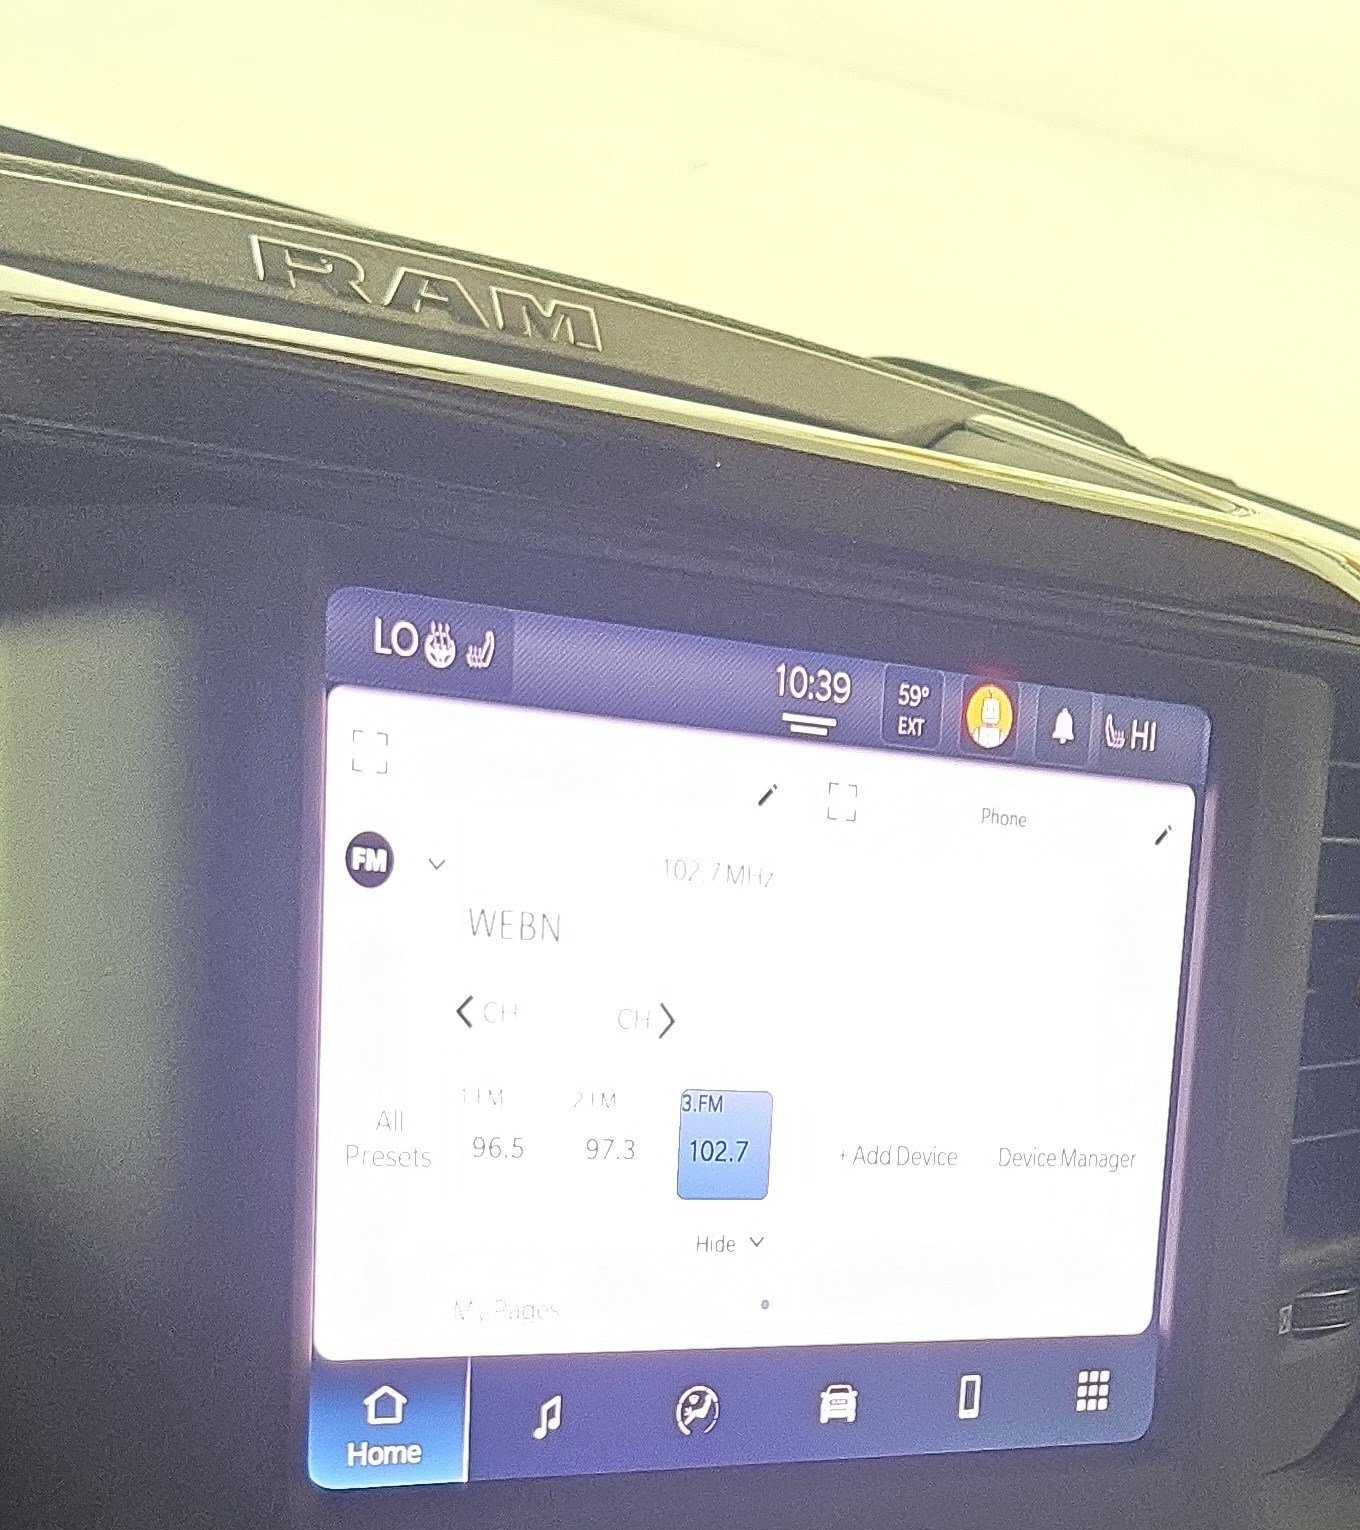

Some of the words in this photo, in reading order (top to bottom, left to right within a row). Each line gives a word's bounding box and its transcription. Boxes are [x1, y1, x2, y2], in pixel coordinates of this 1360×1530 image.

[250, 233, 602, 352] RAM
[374, 616, 419, 657] LO
[776, 663, 852, 704] 10:39
[897, 716, 925, 738] EXT
[1129, 720, 1157, 753] HI
[981, 807, 1027, 829] Phone
[351, 846, 388, 873] FM
[469, 907, 561, 942] WEBN
[375, 1109, 403, 1132] All
[346, 1144, 432, 1167] Presets
[472, 1136, 524, 1159] 96.5
[586, 1138, 636, 1160] 97.3
[689, 1140, 749, 1162] 102.7
[852, 1145, 892, 1166] Add
[896, 1145, 958, 1166] Device
[998, 1146, 1057, 1168] Device
[1060, 1148, 1137, 1172] Manager
[696, 1234, 736, 1253] Hide
[347, 1441, 423, 1467] Home
